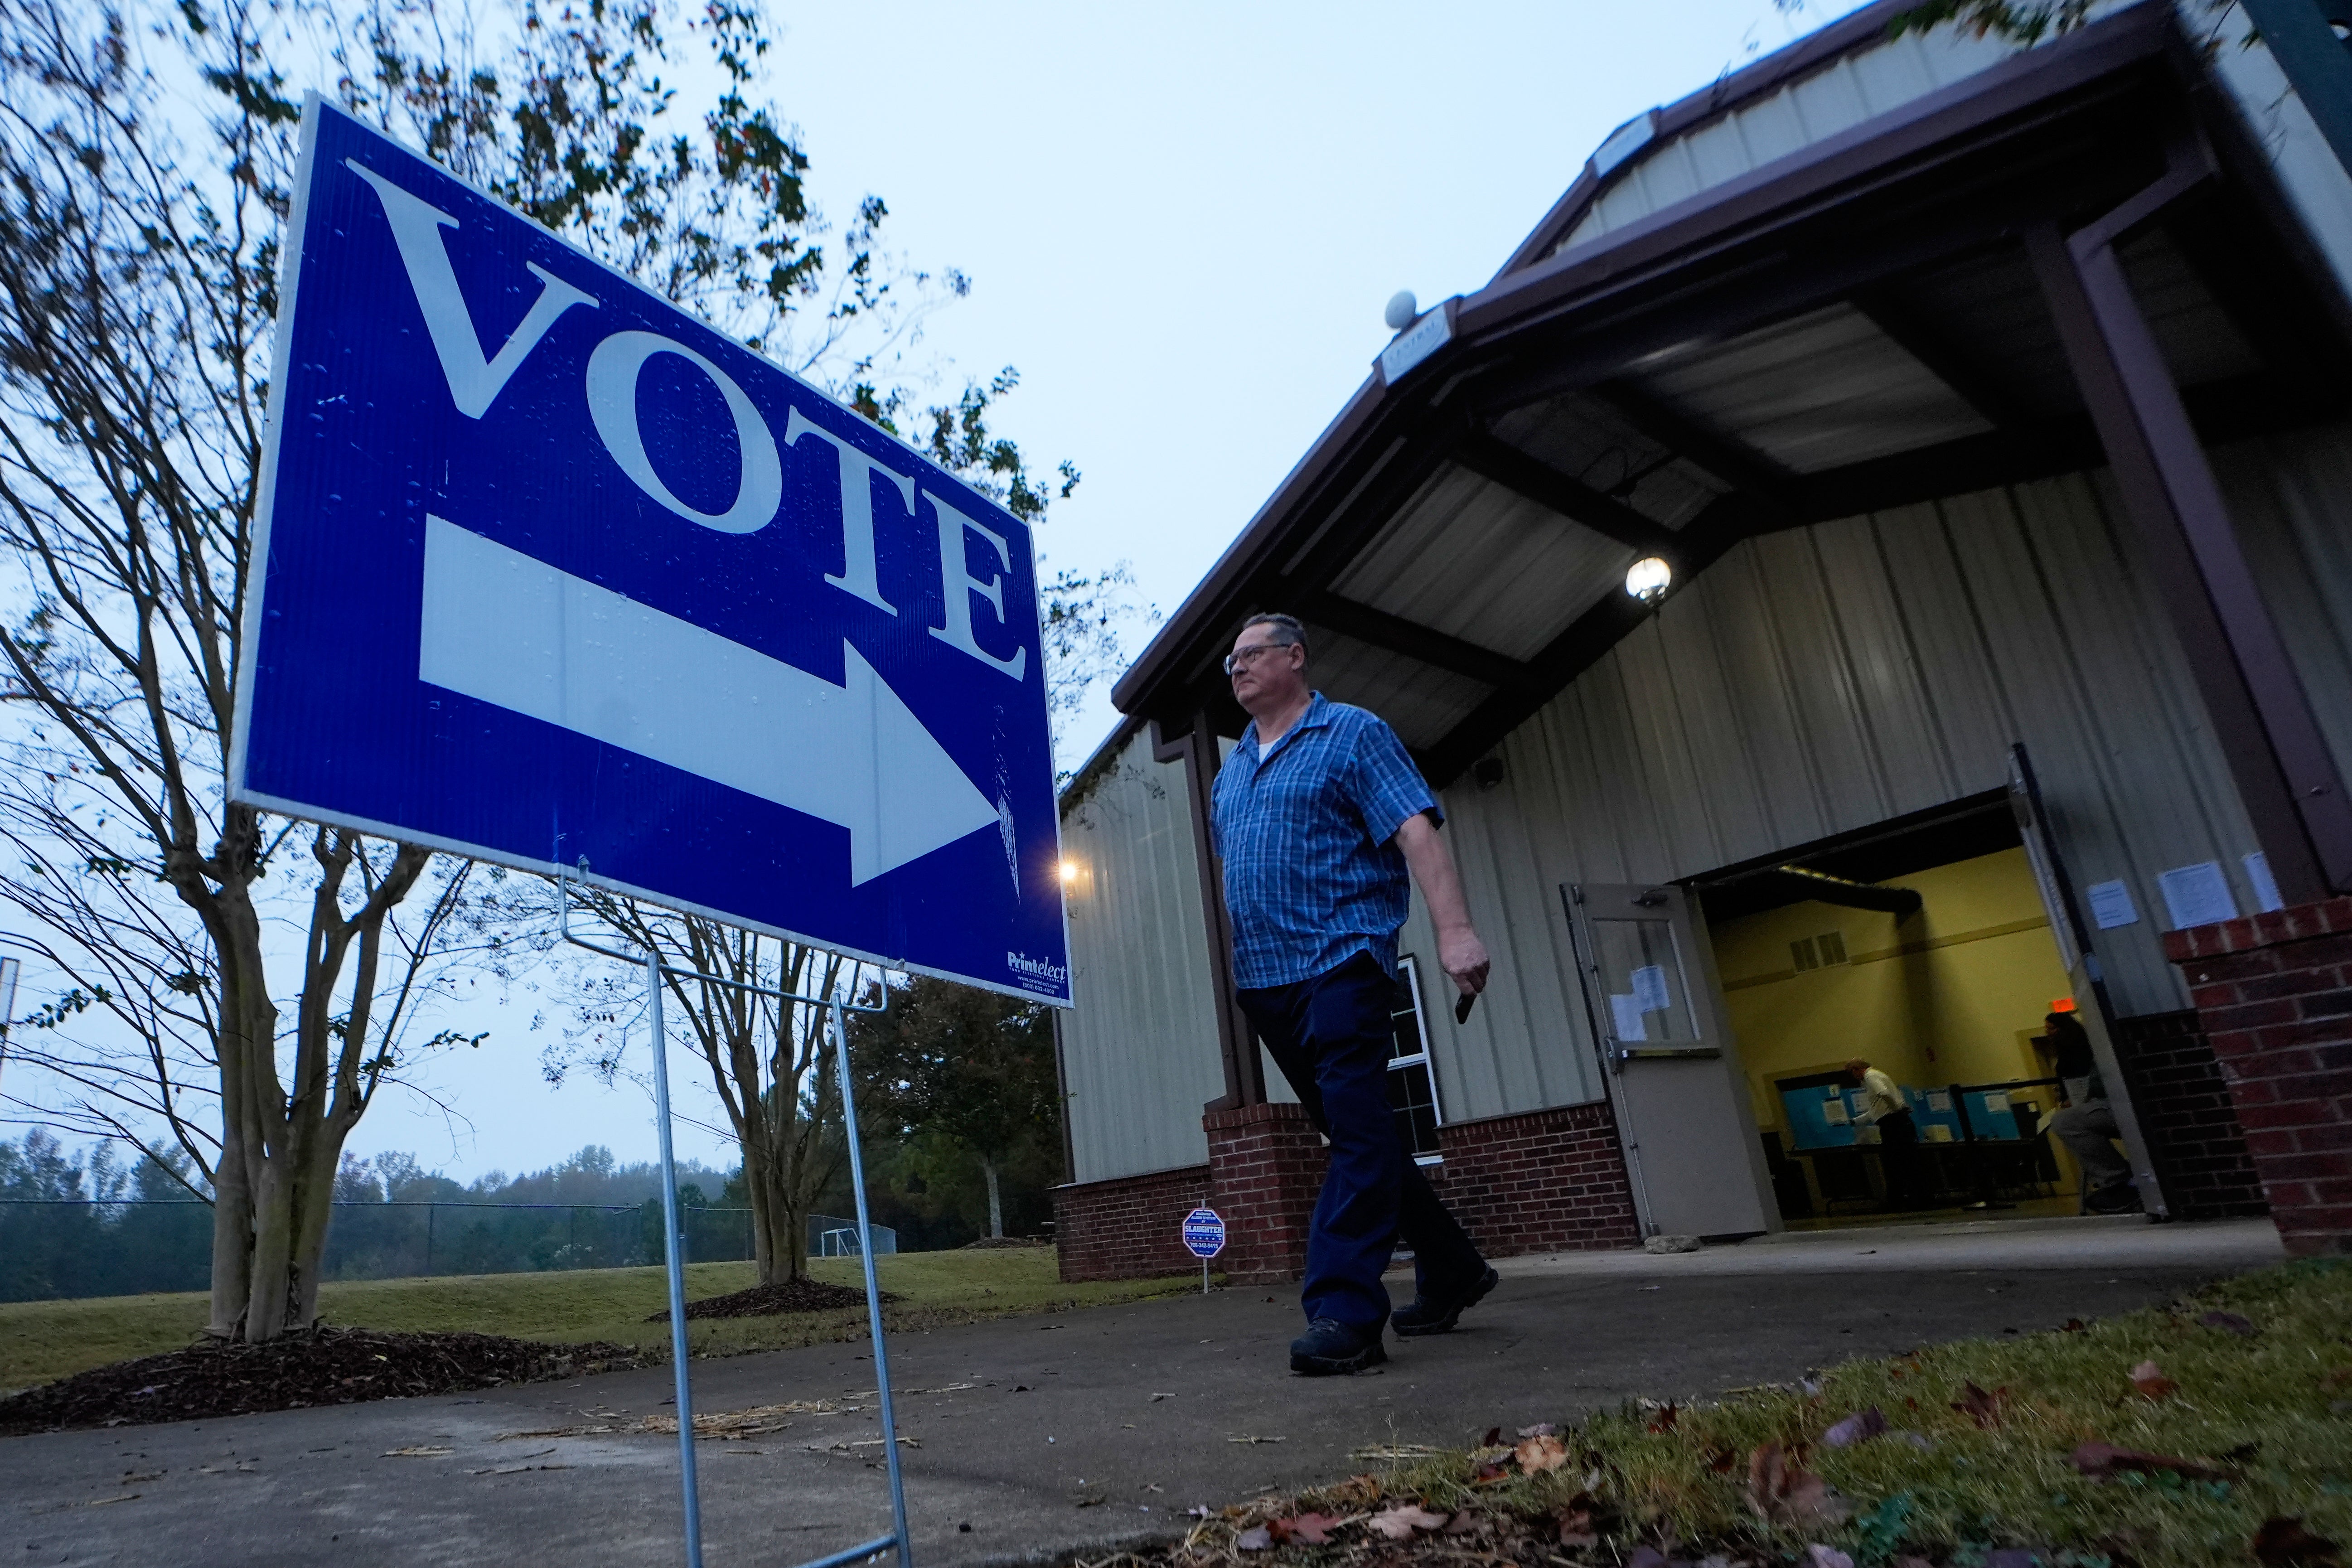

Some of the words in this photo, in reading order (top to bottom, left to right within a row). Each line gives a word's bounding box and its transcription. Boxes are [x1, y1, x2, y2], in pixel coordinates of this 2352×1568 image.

[345, 157, 1026, 682] VOTE
[1007, 951, 1066, 980] Printelect
[1017, 976, 1059, 989] www.printelect.com
